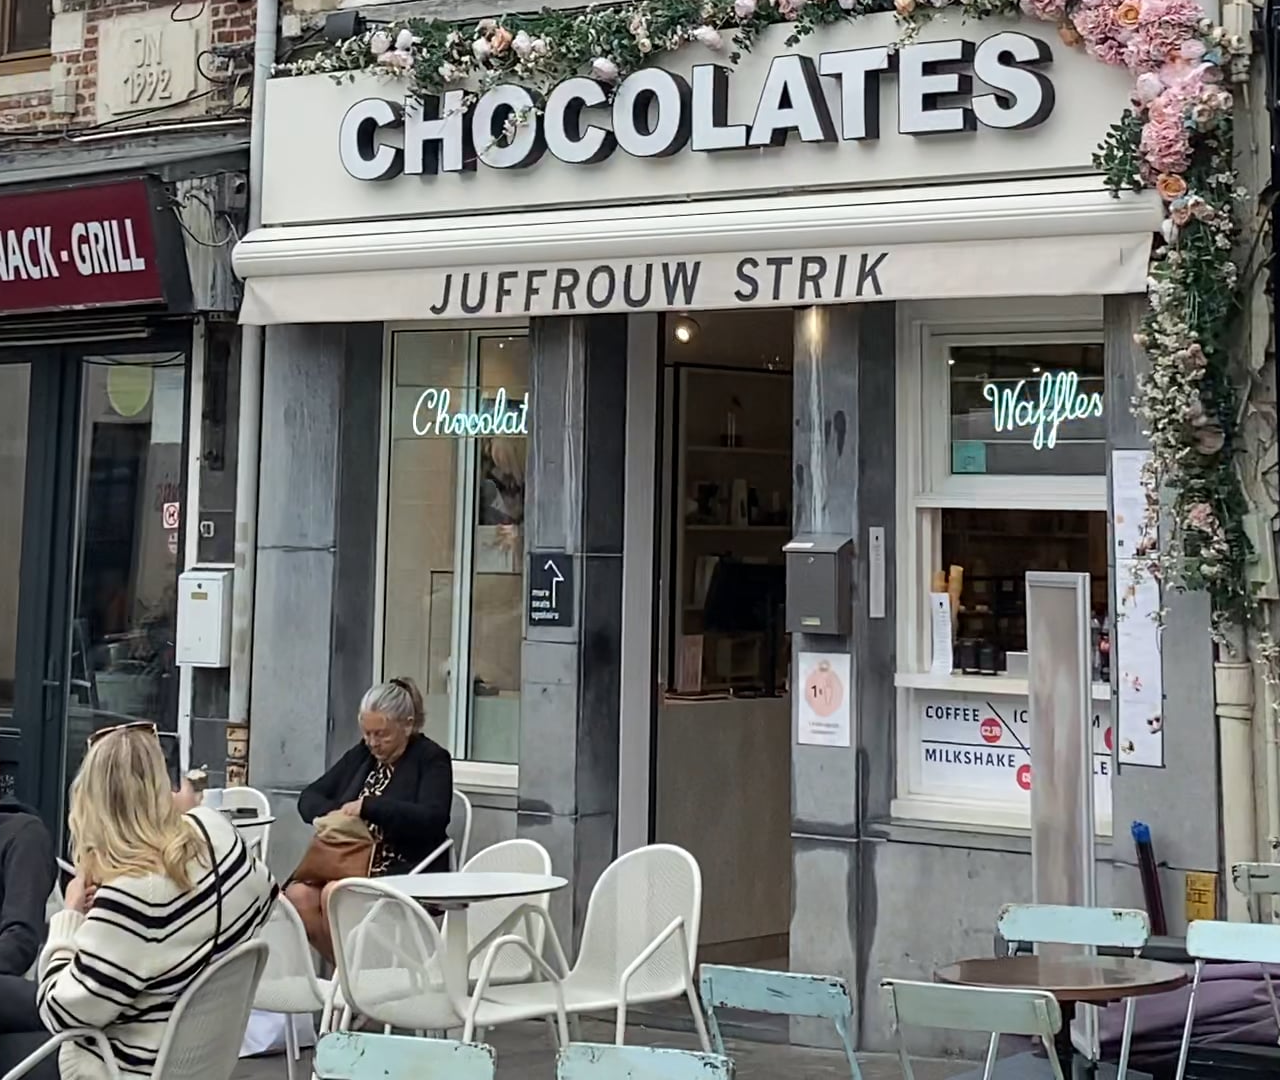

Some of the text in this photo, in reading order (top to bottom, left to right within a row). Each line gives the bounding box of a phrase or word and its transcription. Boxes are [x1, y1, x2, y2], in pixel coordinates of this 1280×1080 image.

[339, 30, 1056, 183] CHOCOLATES
[70, 217, 146, 276] GRILL
[429, 251, 889, 316] JUFFROUW STRIK
[983, 371, 1104, 451] Waffles
[926, 705, 980, 722] COFFEE
[1014, 709, 1028, 724] IC
[925, 747, 1016, 768] MILKSHAKE
